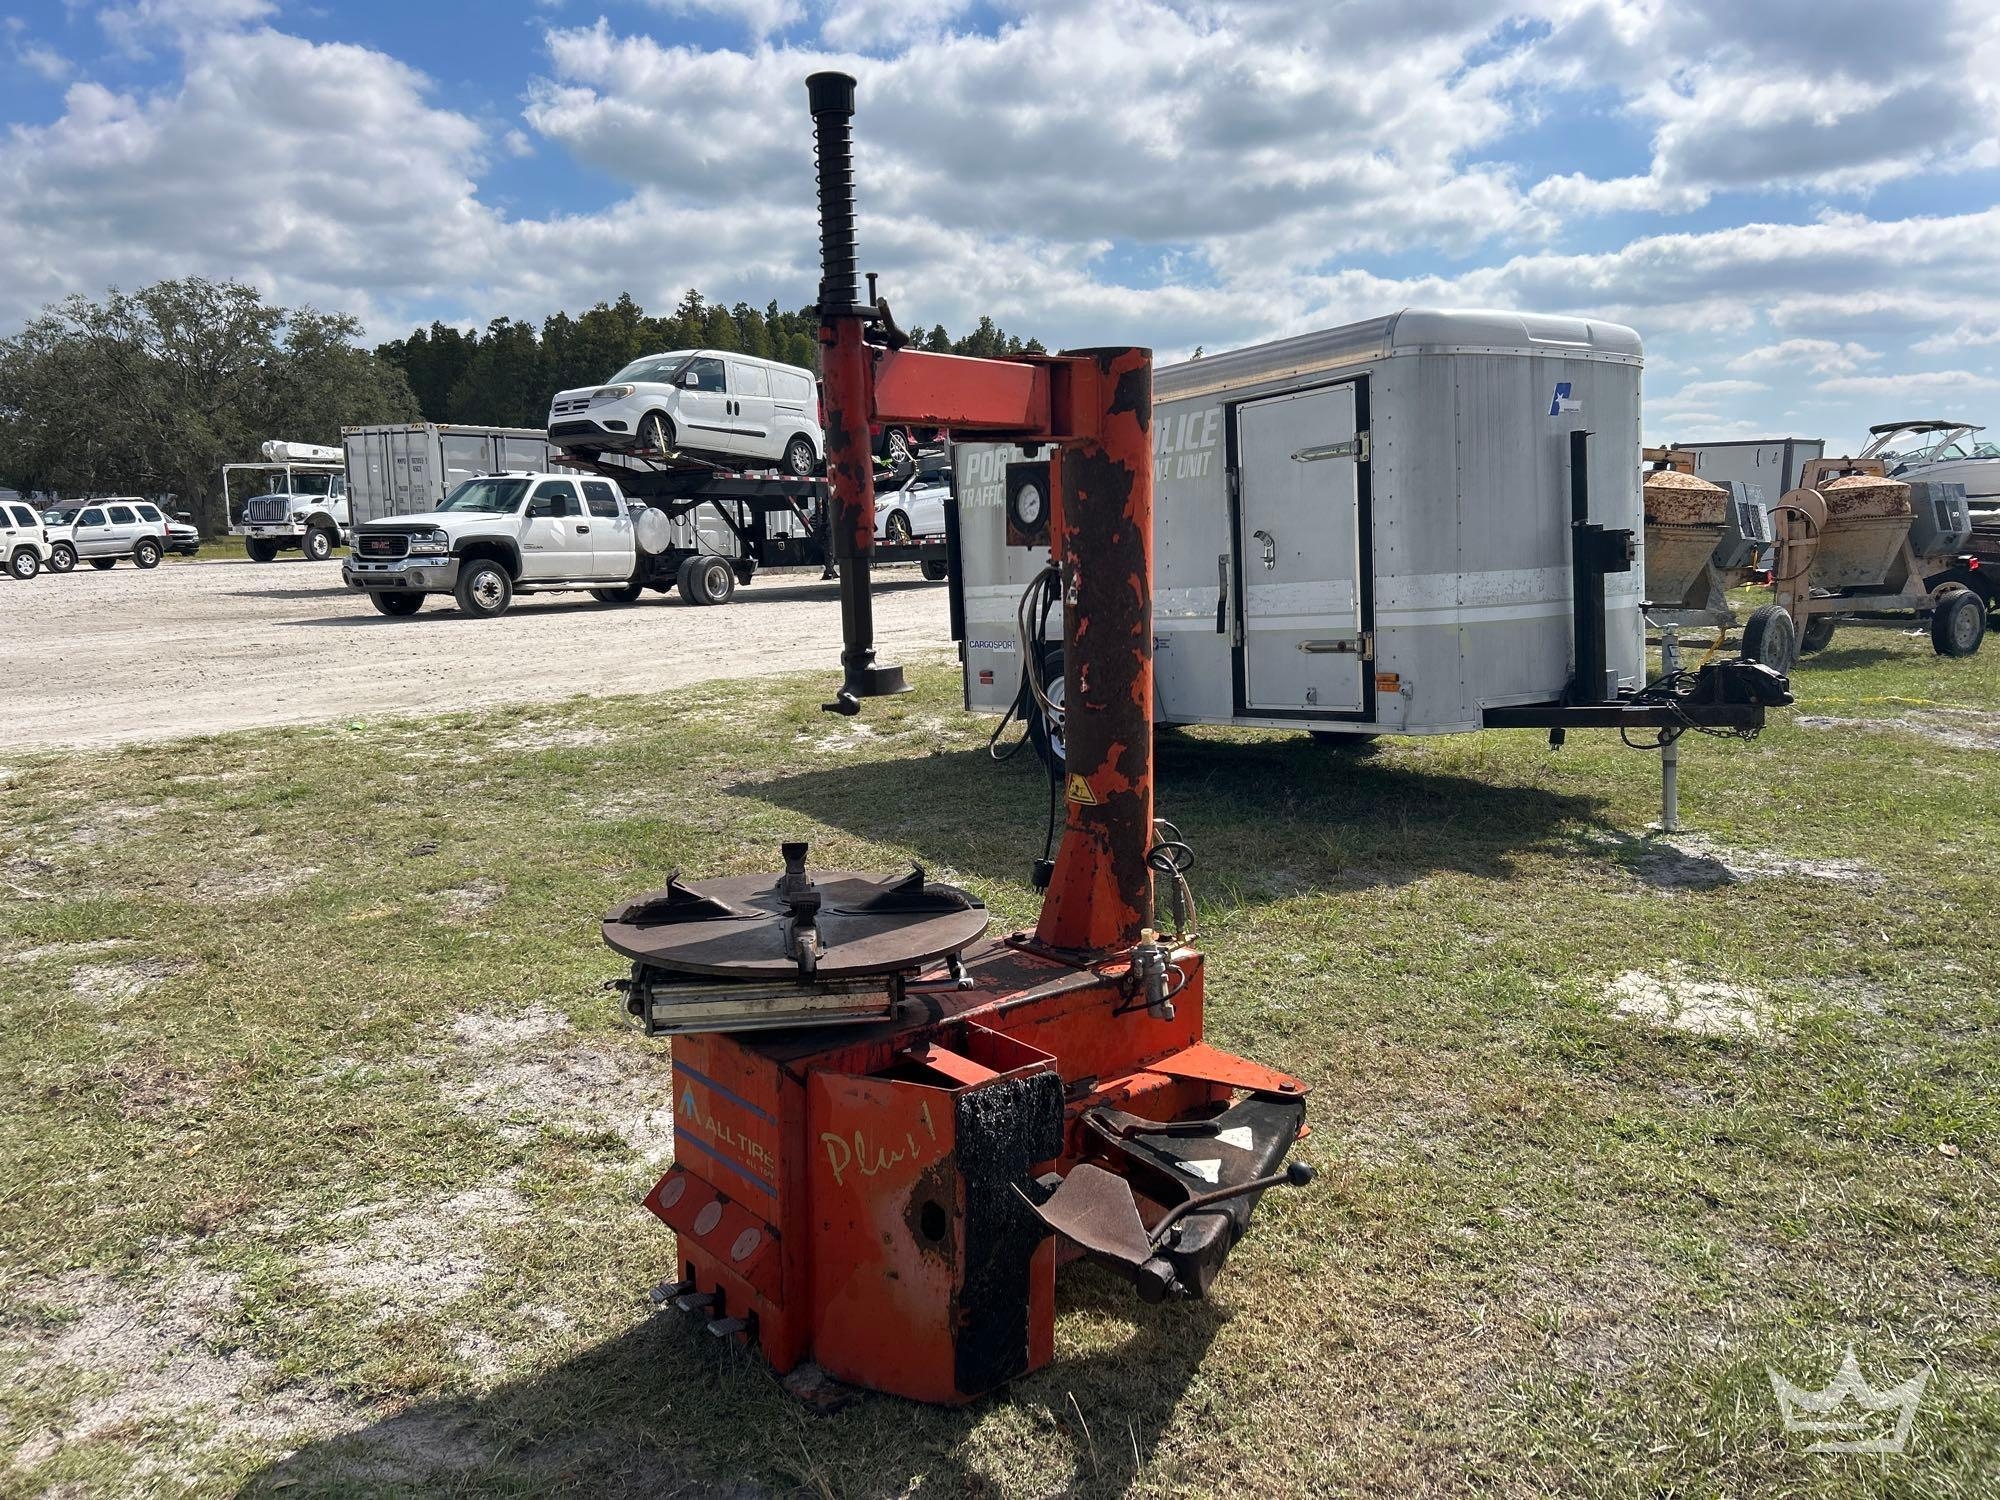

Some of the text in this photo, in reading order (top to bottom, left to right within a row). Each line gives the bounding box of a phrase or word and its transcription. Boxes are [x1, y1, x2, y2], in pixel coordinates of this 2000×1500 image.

[1176, 451, 1212, 479] UNIT
[960, 483, 1004, 509] TRAFFIC
[371, 541, 390, 549] GMC
[969, 640, 1016, 649] CARGOSPORT
[705, 1115, 775, 1170] ALL TIRE
